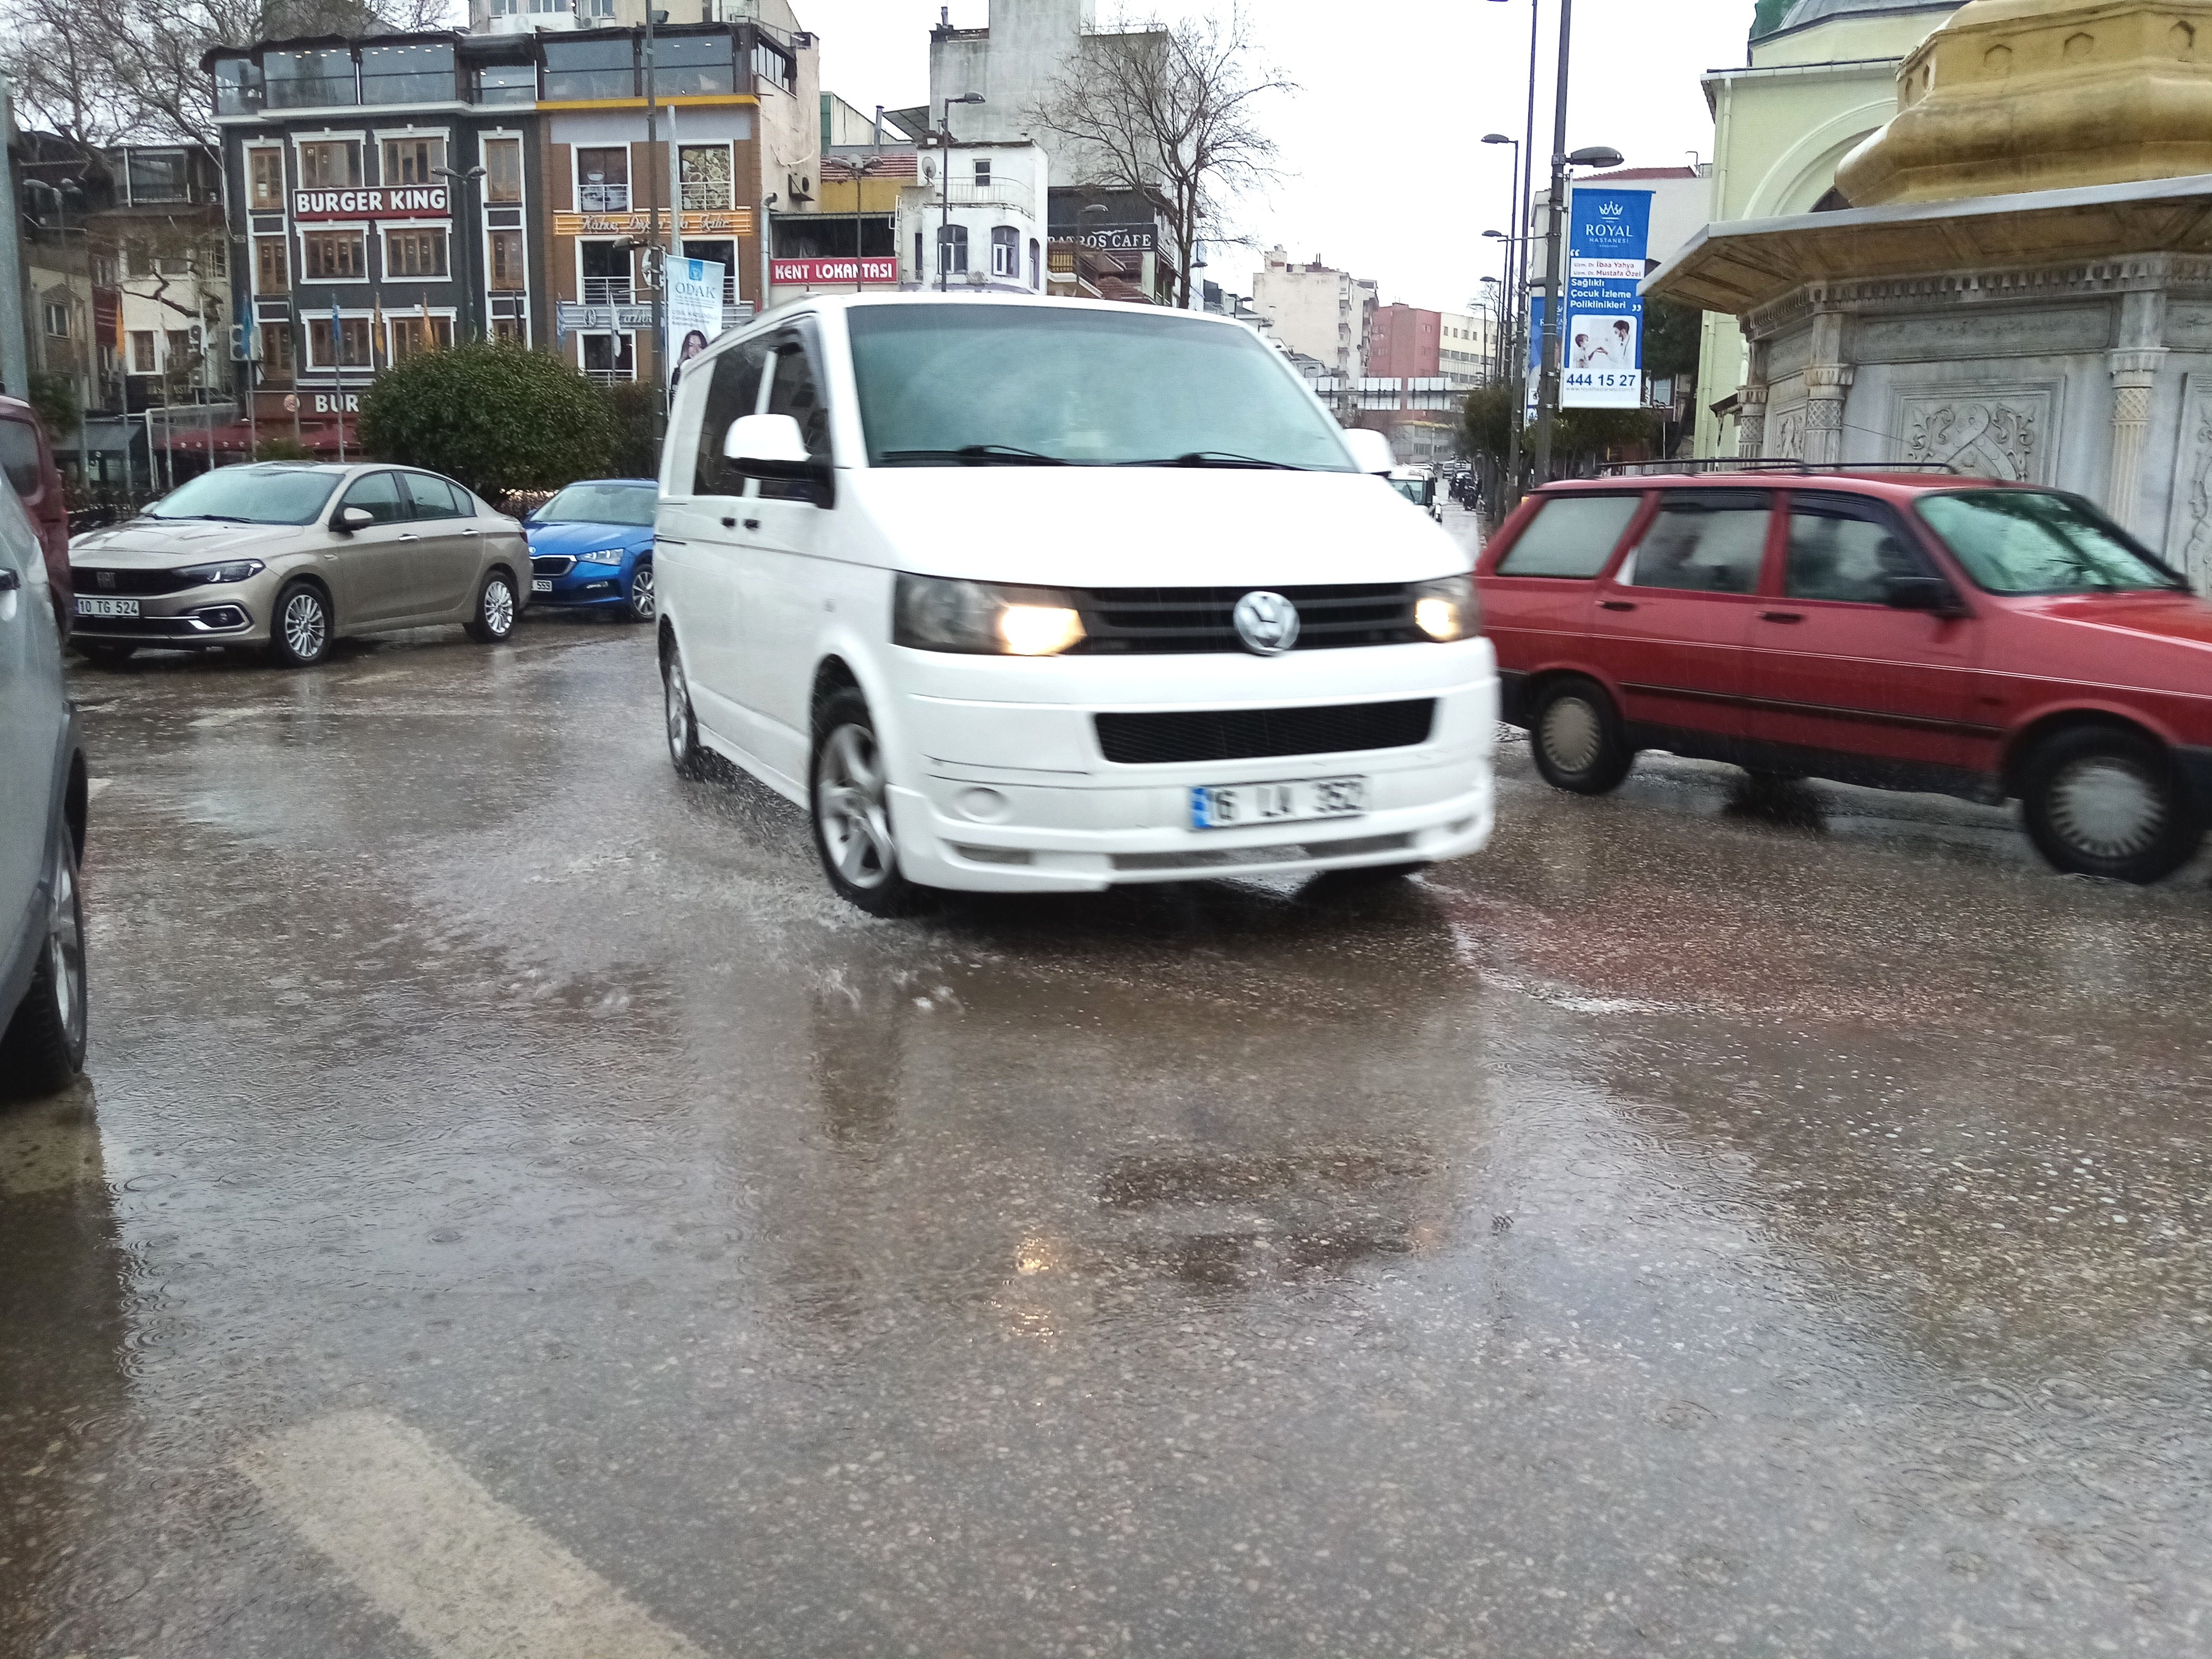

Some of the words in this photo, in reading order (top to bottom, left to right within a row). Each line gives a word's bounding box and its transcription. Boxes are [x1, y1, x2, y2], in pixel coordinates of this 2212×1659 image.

[297, 191, 383, 213] BURGER
[390, 189, 446, 210] KING
[1586, 224, 1633, 237] ROYAL
[1112, 234, 1152, 247] CAFE
[775, 264, 809, 280] KENT
[816, 263, 892, 279] LOKANTASI
[1571, 278, 1605, 288] Sağlıklı
[675, 282, 715, 298] ODAK
[1570, 289, 1599, 298] Çocuk
[1602, 288, 1632, 298] İzleme
[1570, 300, 1627, 309] Poliklinikleri
[1566, 373, 1593, 386] 444
[1598, 374, 1614, 387] 15
[1619, 374, 1636, 387] 27
[79, 600, 91, 613] 10
[96, 600, 111, 614] TG
[116, 601, 138, 615] 524
